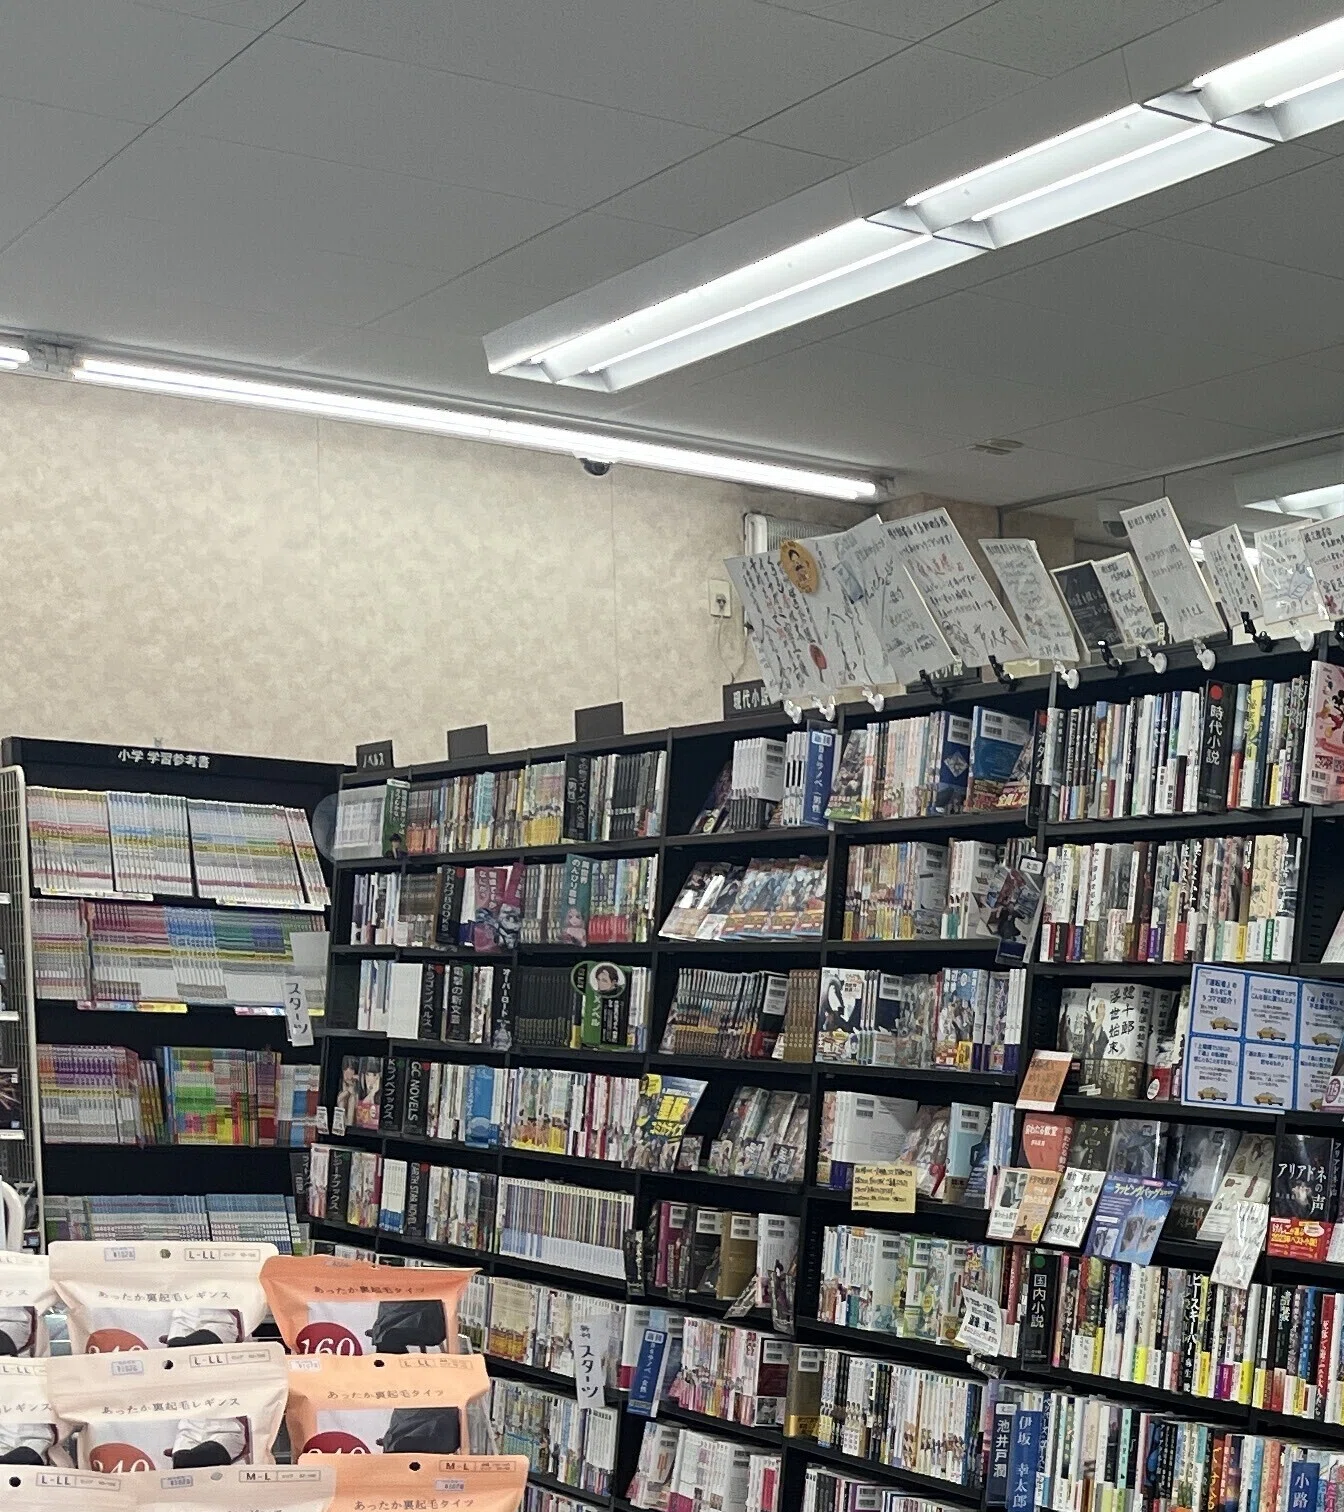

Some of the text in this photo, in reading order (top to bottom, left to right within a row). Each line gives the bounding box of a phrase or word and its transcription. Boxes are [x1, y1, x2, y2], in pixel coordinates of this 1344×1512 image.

[1206, 706, 1224, 768] 時代小説
[117, 749, 212, 770] 小学 学習参考書
[97, 1288, 232, 1303] あったか裏起毛レギンス
[311, 1283, 426, 1296] あったか裏起毛タイツ
[1029, 1273, 1047, 1330] 国内小説
[101, 1396, 241, 1415] あったか裏起毛レギンス
[1012, 1416, 1034, 1511] 伊坂 幸太郎
[1293, 1474, 1311, 1508] 小路
